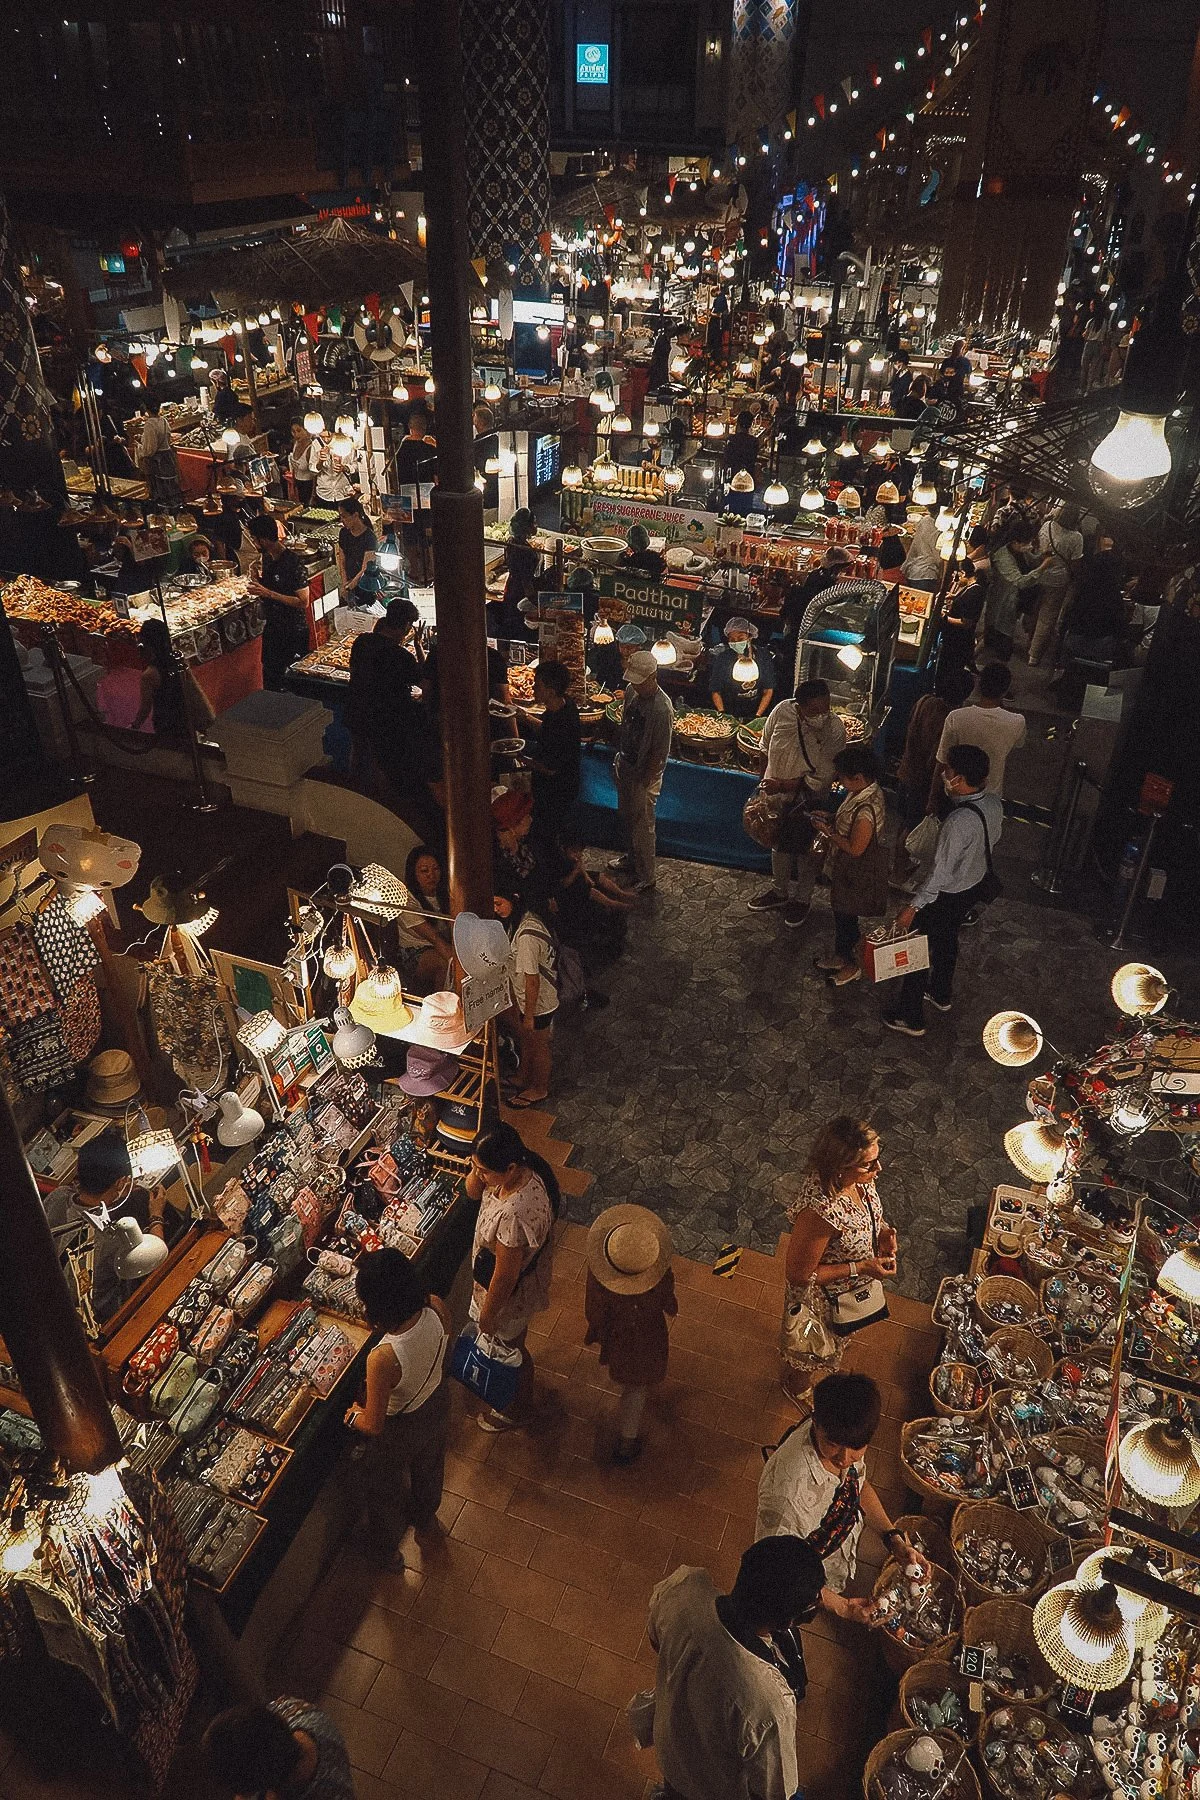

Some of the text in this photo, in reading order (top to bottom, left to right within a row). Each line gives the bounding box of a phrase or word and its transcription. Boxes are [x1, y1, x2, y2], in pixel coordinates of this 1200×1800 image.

[593, 502, 686, 524] FRESH SUGARCANE JUICE
[614, 582, 689, 610] Padthai
[468, 983, 504, 1011] Free name
